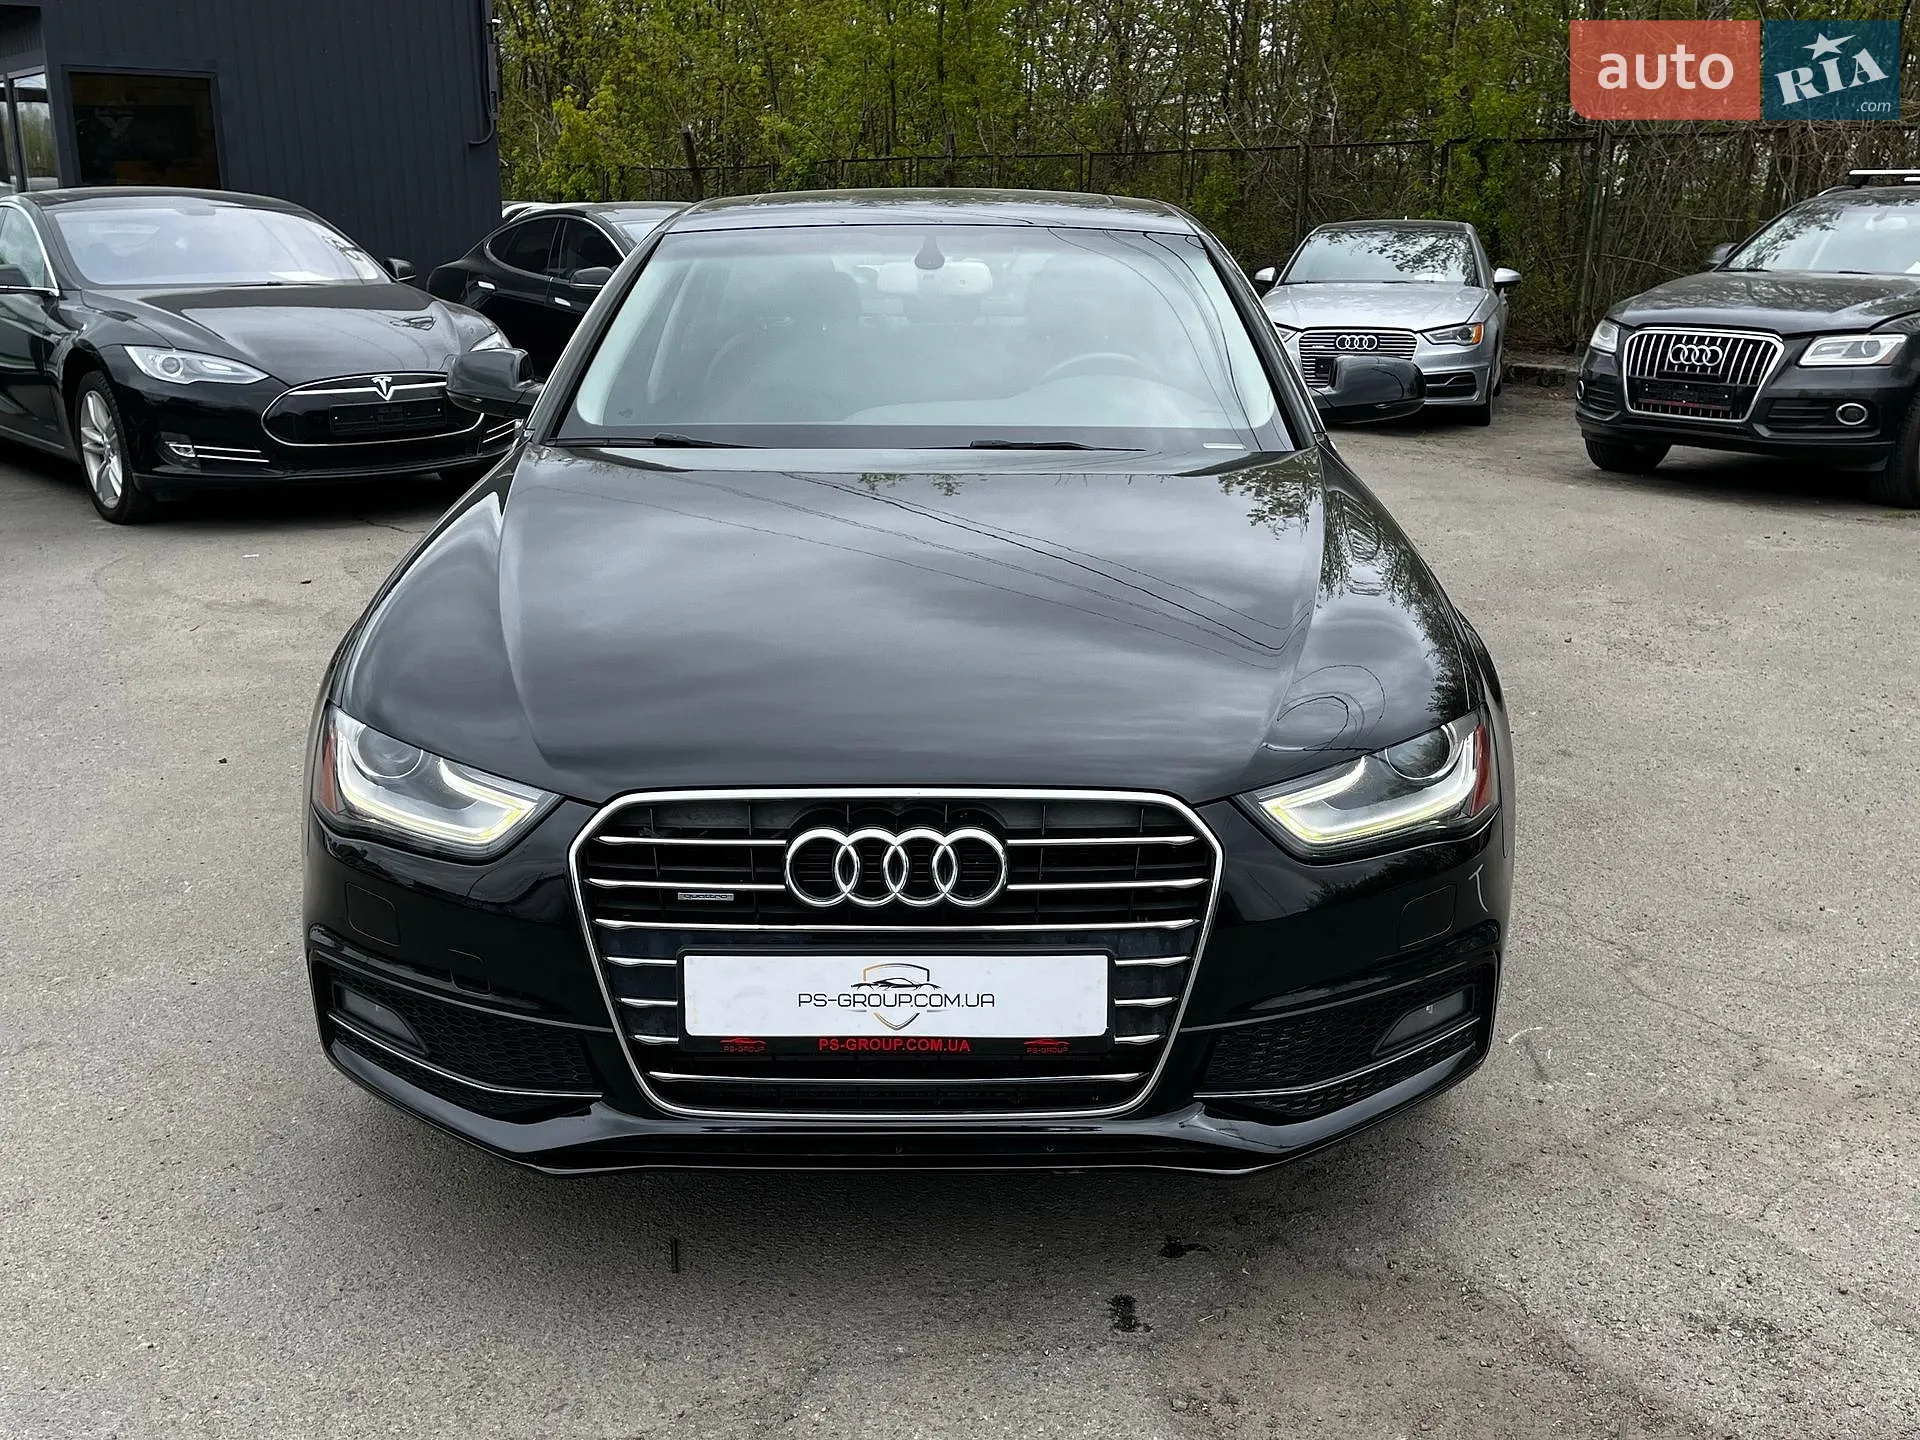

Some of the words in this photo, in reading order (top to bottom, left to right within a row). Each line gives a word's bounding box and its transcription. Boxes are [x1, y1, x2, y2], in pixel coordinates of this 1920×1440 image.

[683, 893, 729, 901] quattro
[798, 993, 996, 1008] PS-GROUP.COM.UA
[818, 1038, 971, 1053] PS-GROUP.COM.UA
